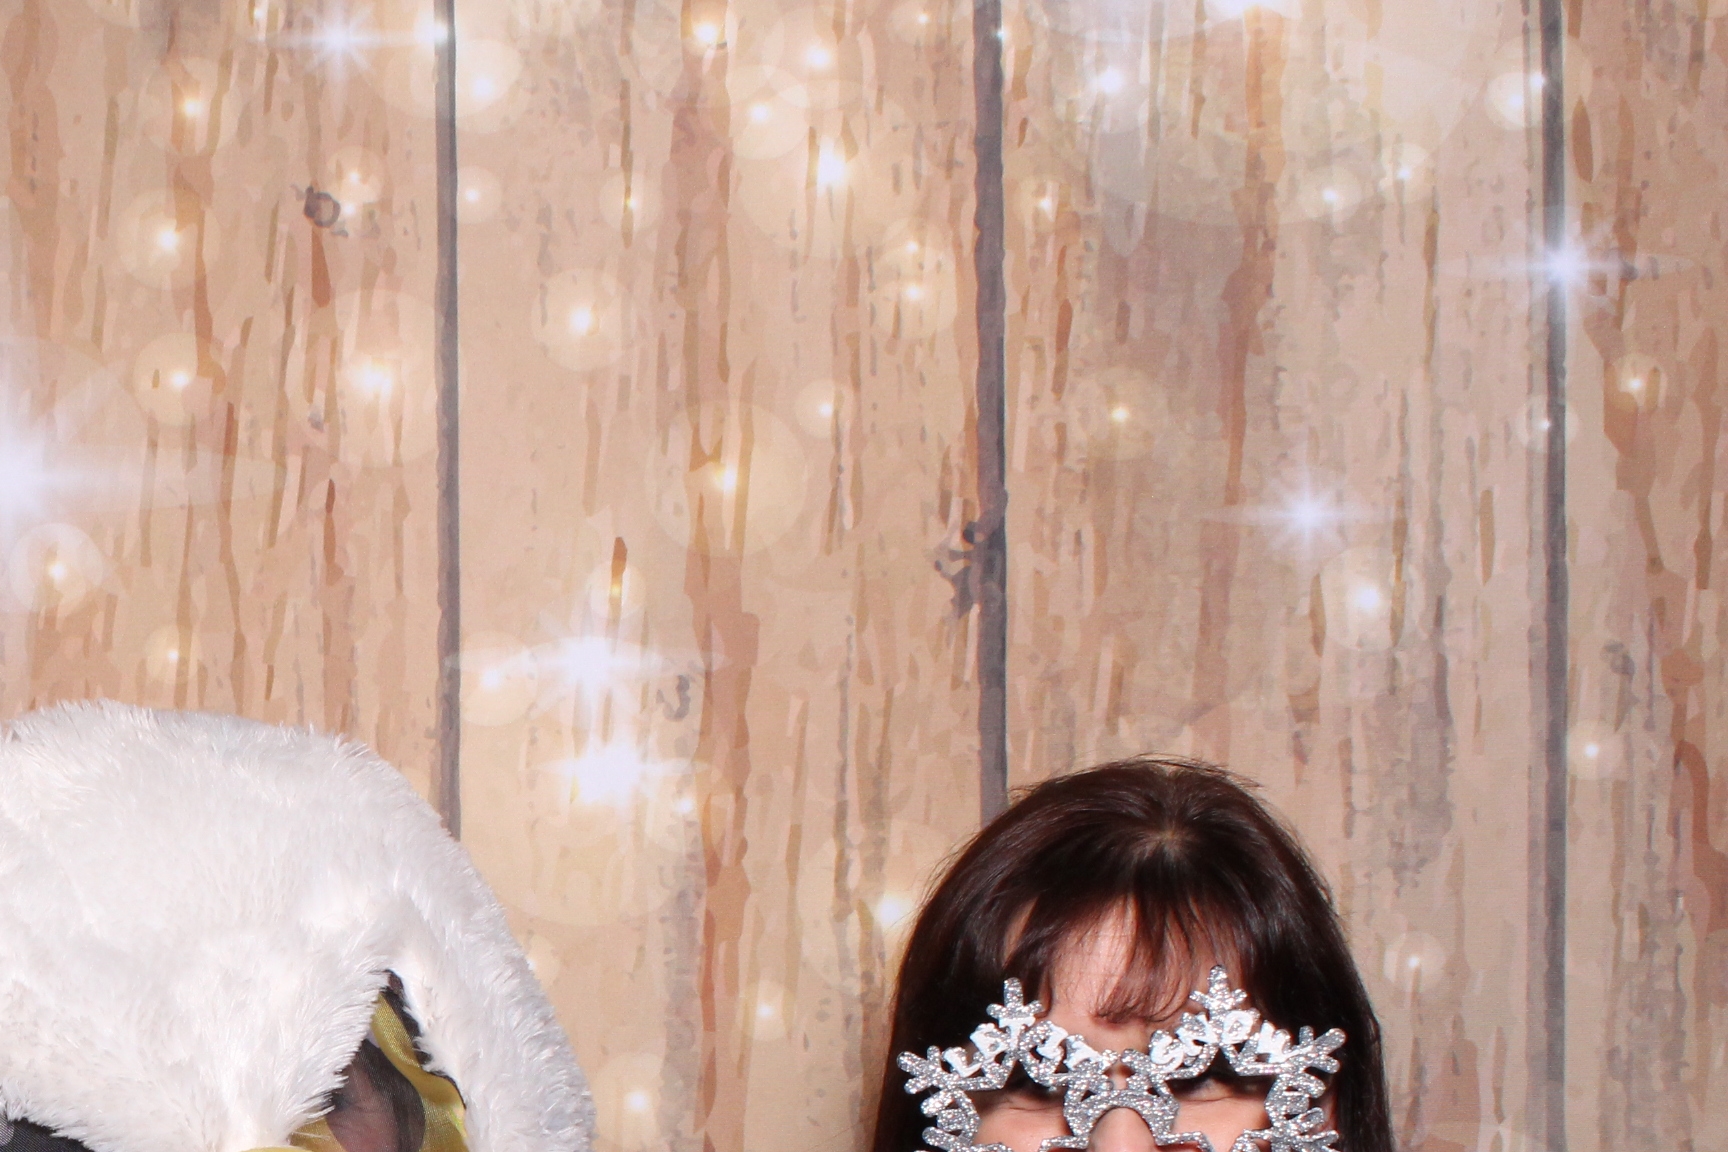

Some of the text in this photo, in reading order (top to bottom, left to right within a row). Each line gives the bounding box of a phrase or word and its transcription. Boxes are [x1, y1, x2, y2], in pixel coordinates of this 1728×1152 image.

[941, 1010, 1314, 1078] LET IT SNOW
